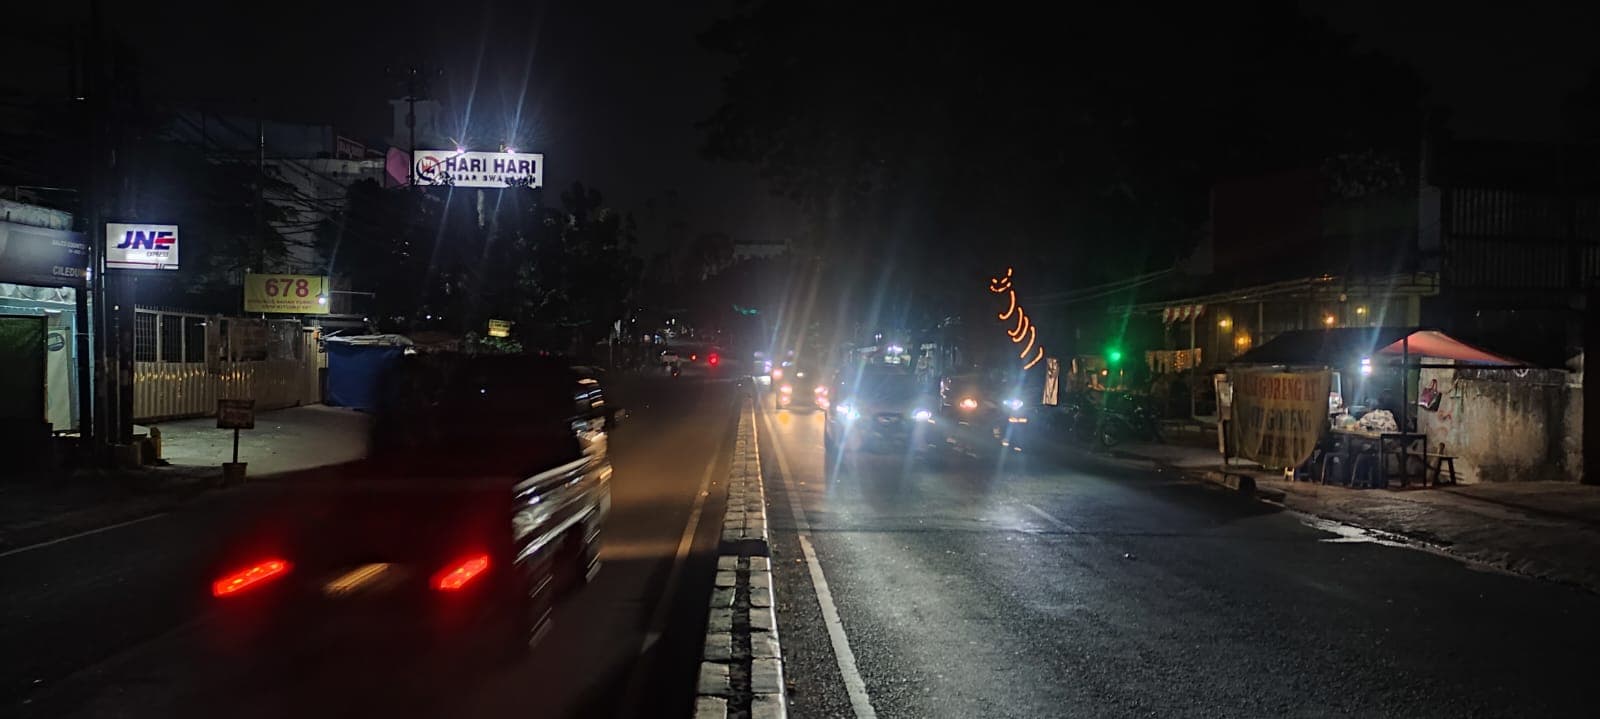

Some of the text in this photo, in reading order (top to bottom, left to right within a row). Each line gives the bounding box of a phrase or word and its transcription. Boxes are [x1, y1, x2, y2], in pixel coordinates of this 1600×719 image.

[446, 157, 536, 174] HARI HARI
[117, 231, 176, 250] JNE
[52, 265, 87, 278] CILEDU
[265, 278, 309, 297] 678
[1259, 377, 1303, 401] GORENG
